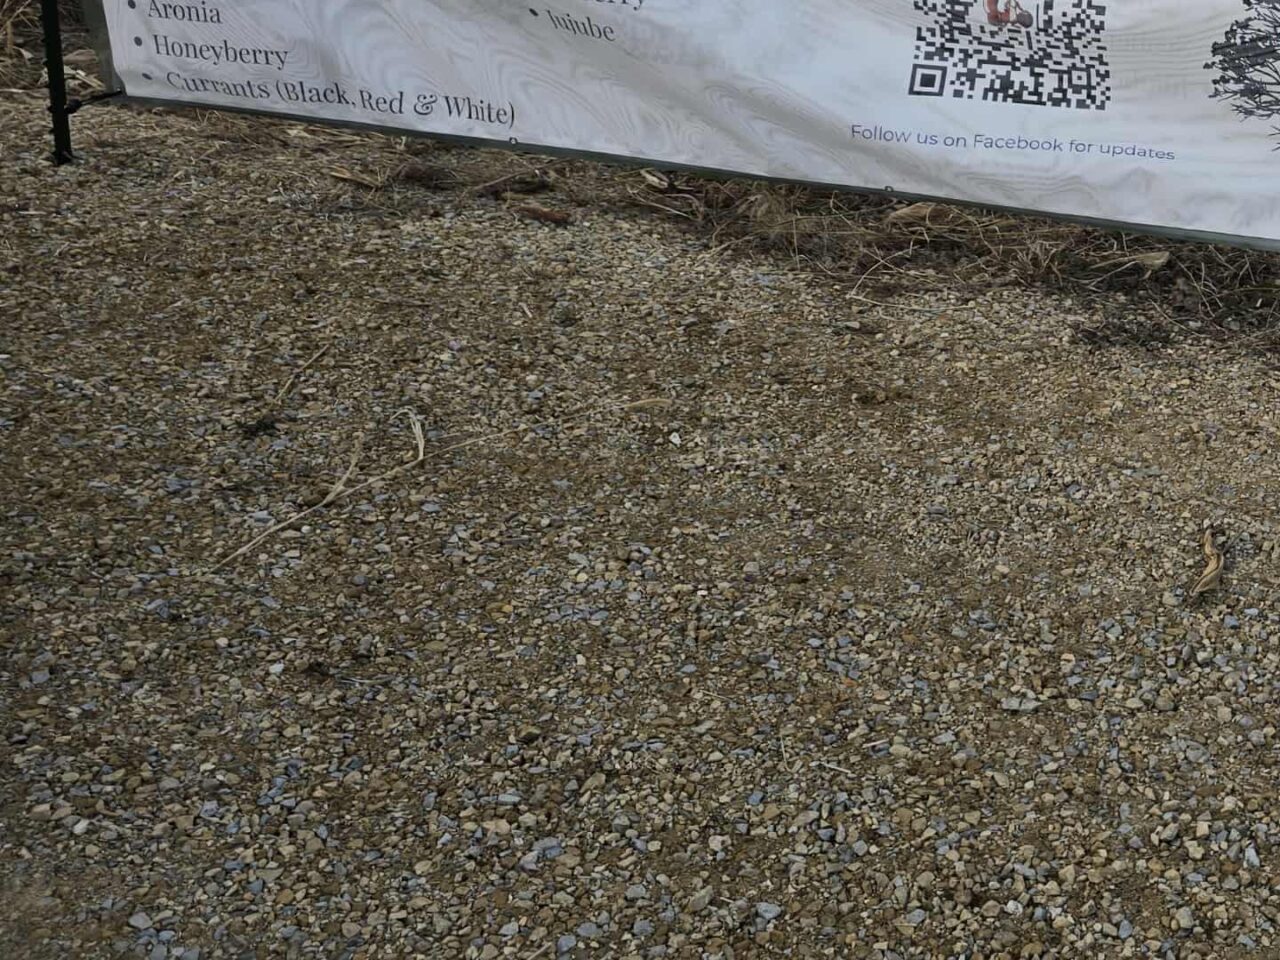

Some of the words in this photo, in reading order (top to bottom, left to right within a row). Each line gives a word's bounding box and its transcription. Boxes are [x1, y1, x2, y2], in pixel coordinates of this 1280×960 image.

[152, 35, 289, 69] Honeyberry
[166, 71, 271, 100] Currants
[276, 79, 356, 108] (Black,
[359, 90, 404, 115] Red
[413, 93, 441, 114] &
[443, 95, 516, 128] White)
[851, 124, 912, 144] Follow
[917, 132, 938, 146] us
[943, 134, 968, 149] on
[973, 133, 1064, 153] Facebook
[1069, 138, 1095, 154] for
[1099, 142, 1175, 162] updates
